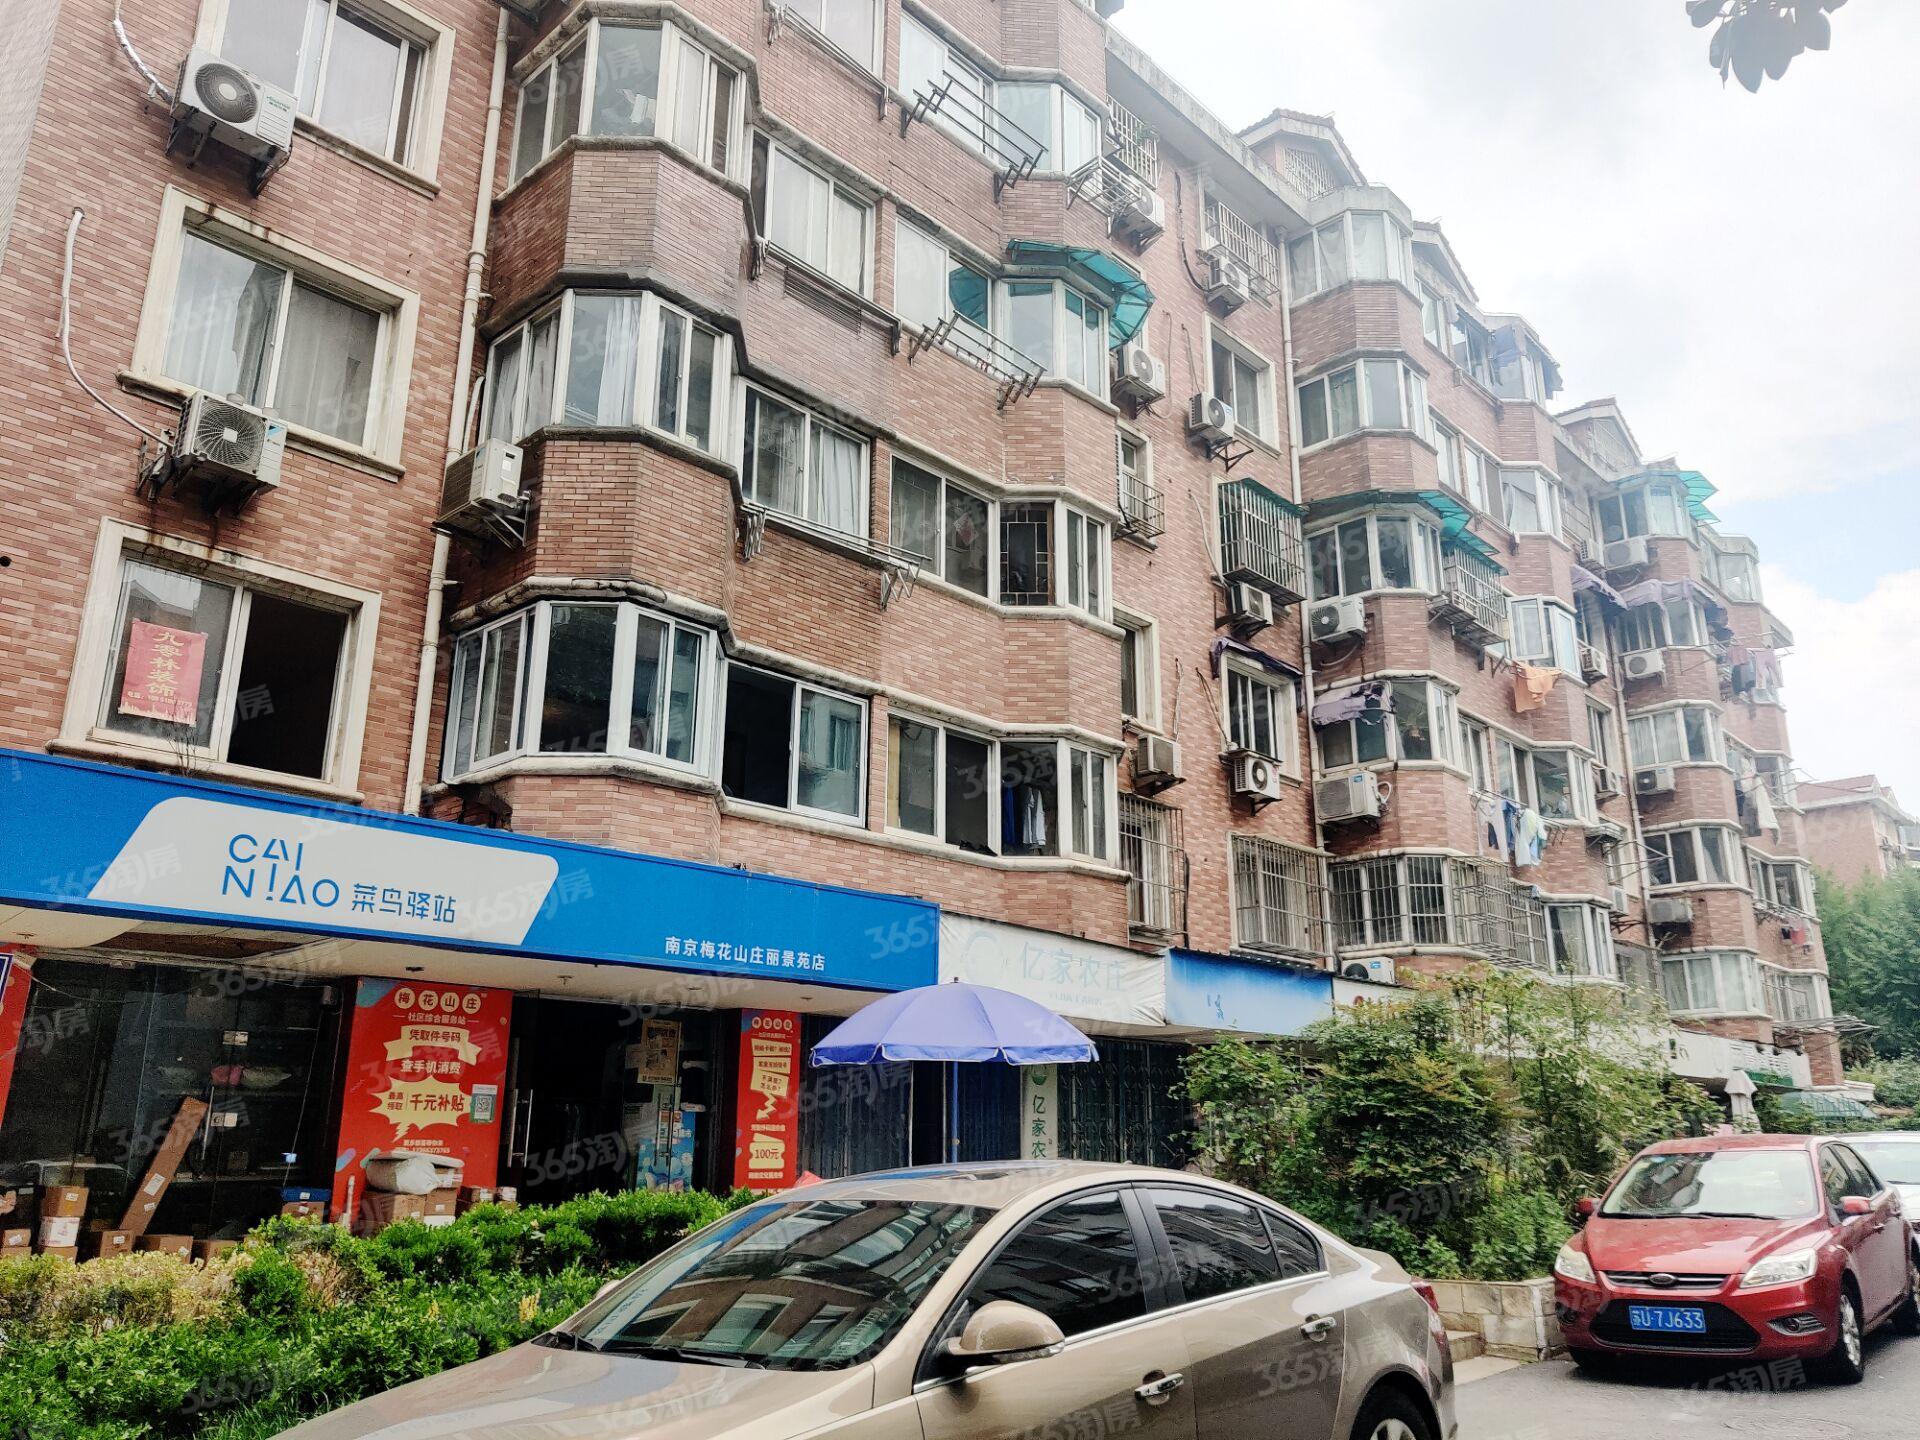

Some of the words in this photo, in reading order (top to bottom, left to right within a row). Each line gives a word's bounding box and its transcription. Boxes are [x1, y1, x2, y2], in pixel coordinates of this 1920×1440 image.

[228, 834, 303, 872] CAI
[351, 882, 457, 924] 菜鸟驿站
[664, 935, 826, 972] 南京梅花山庄丽景苑店
[396, 989, 480, 1013] 梅花山庄
[409, 1029, 462, 1043] 凭取件号码
[400, 1059, 461, 1075] 查手机消费
[409, 1093, 465, 1112] 千元补贴
[1031, 1094, 1047, 1159] 亿家农
[754, 1148, 780, 1160] 100元
